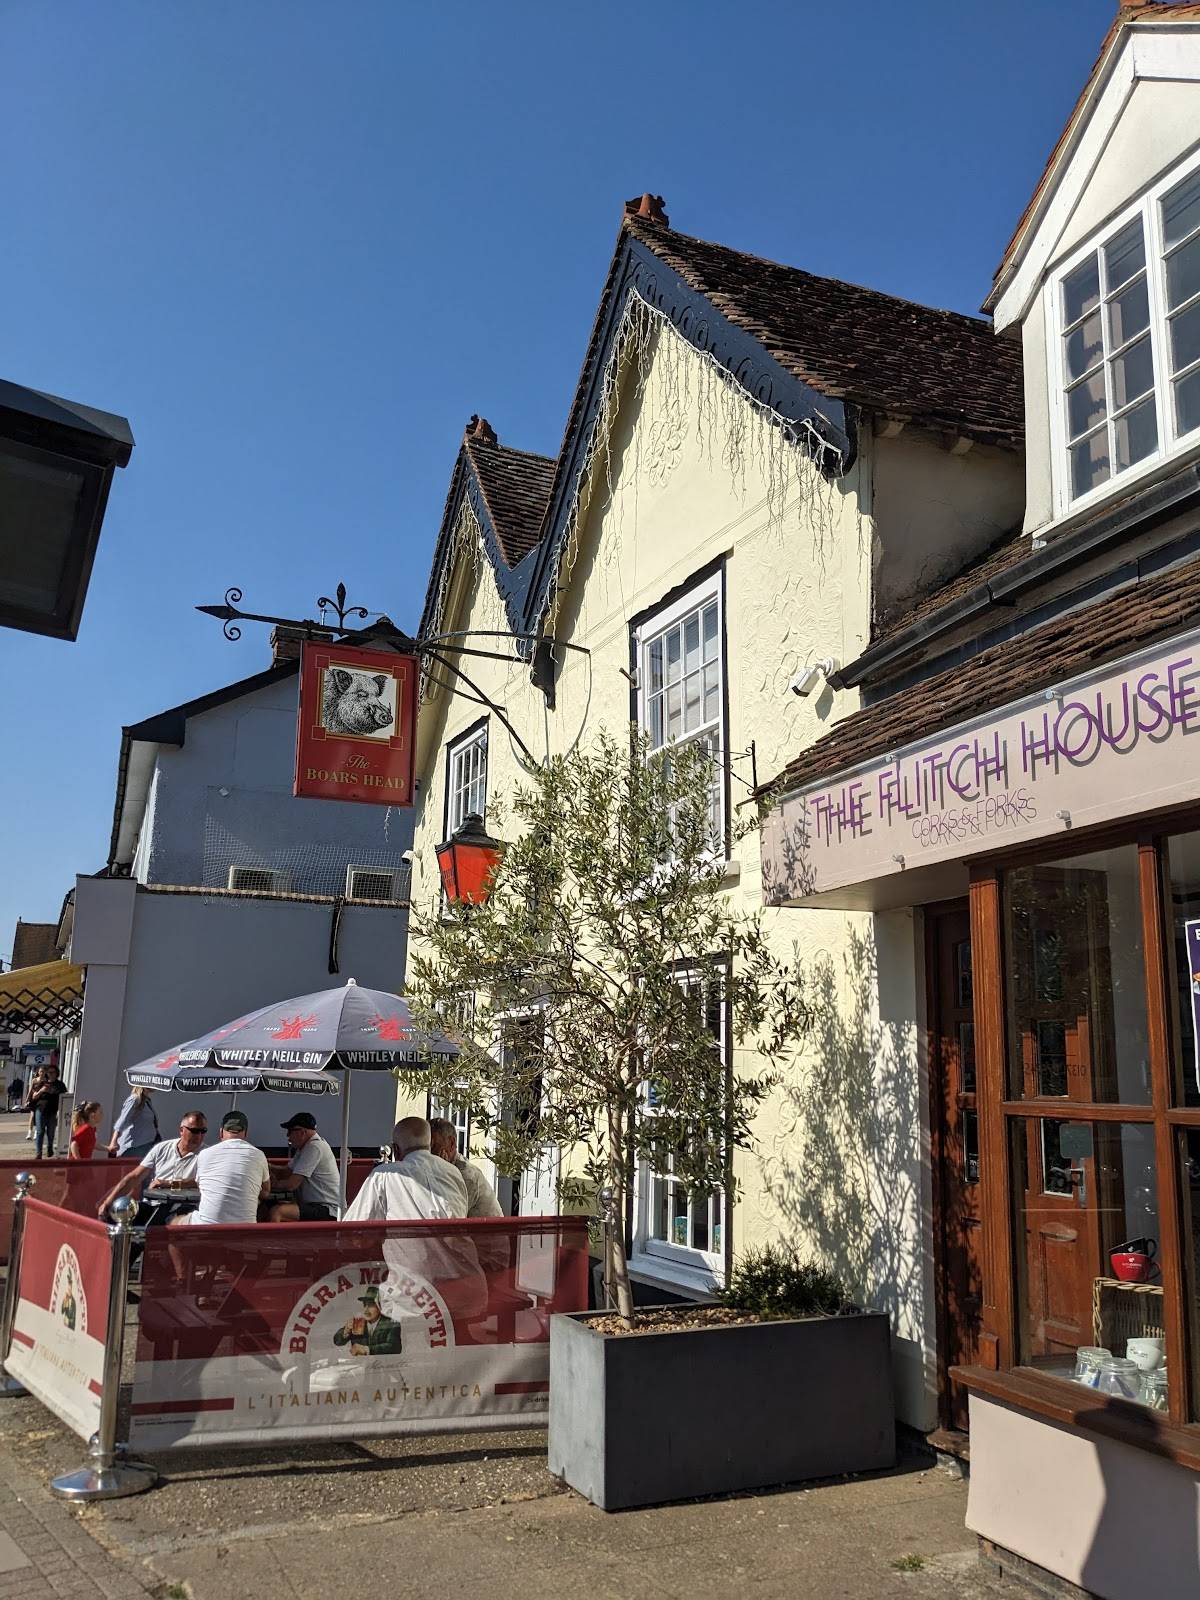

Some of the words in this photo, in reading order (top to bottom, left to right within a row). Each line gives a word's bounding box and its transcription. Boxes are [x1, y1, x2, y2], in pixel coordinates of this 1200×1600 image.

[810, 781, 864, 838] THE
[878, 731, 1001, 818] FLITCH
[1020, 657, 1197, 773] HOUSE
[345, 754, 369, 769] The
[306, 768, 359, 785] BOARS
[363, 774, 405, 789] HEAD
[912, 808, 960, 841] CORKS
[976, 787, 1030, 824] FORKS
[220, 1049, 270, 1061] WHITLEY
[271, 1050, 301, 1063] NEILL
[303, 1052, 323, 1065] GIN
[346, 1050, 395, 1063] WHITLEY
[400, 1050, 426, 1063] NEIL
[182, 1078, 217, 1086] WHITLEY
[219, 1077, 240, 1086] NEILL
[241, 1077, 255, 1085] GIN
[267, 1078, 293, 1089] WHITLEY
[293, 1080, 311, 1090] NEILL
[311, 1082, 323, 1091] GIN
[289, 1274, 354, 1354] BIRRA
[248, 1390, 361, 1410] L'ITALIANA
[373, 1384, 482, 1402] AUTENTICA
